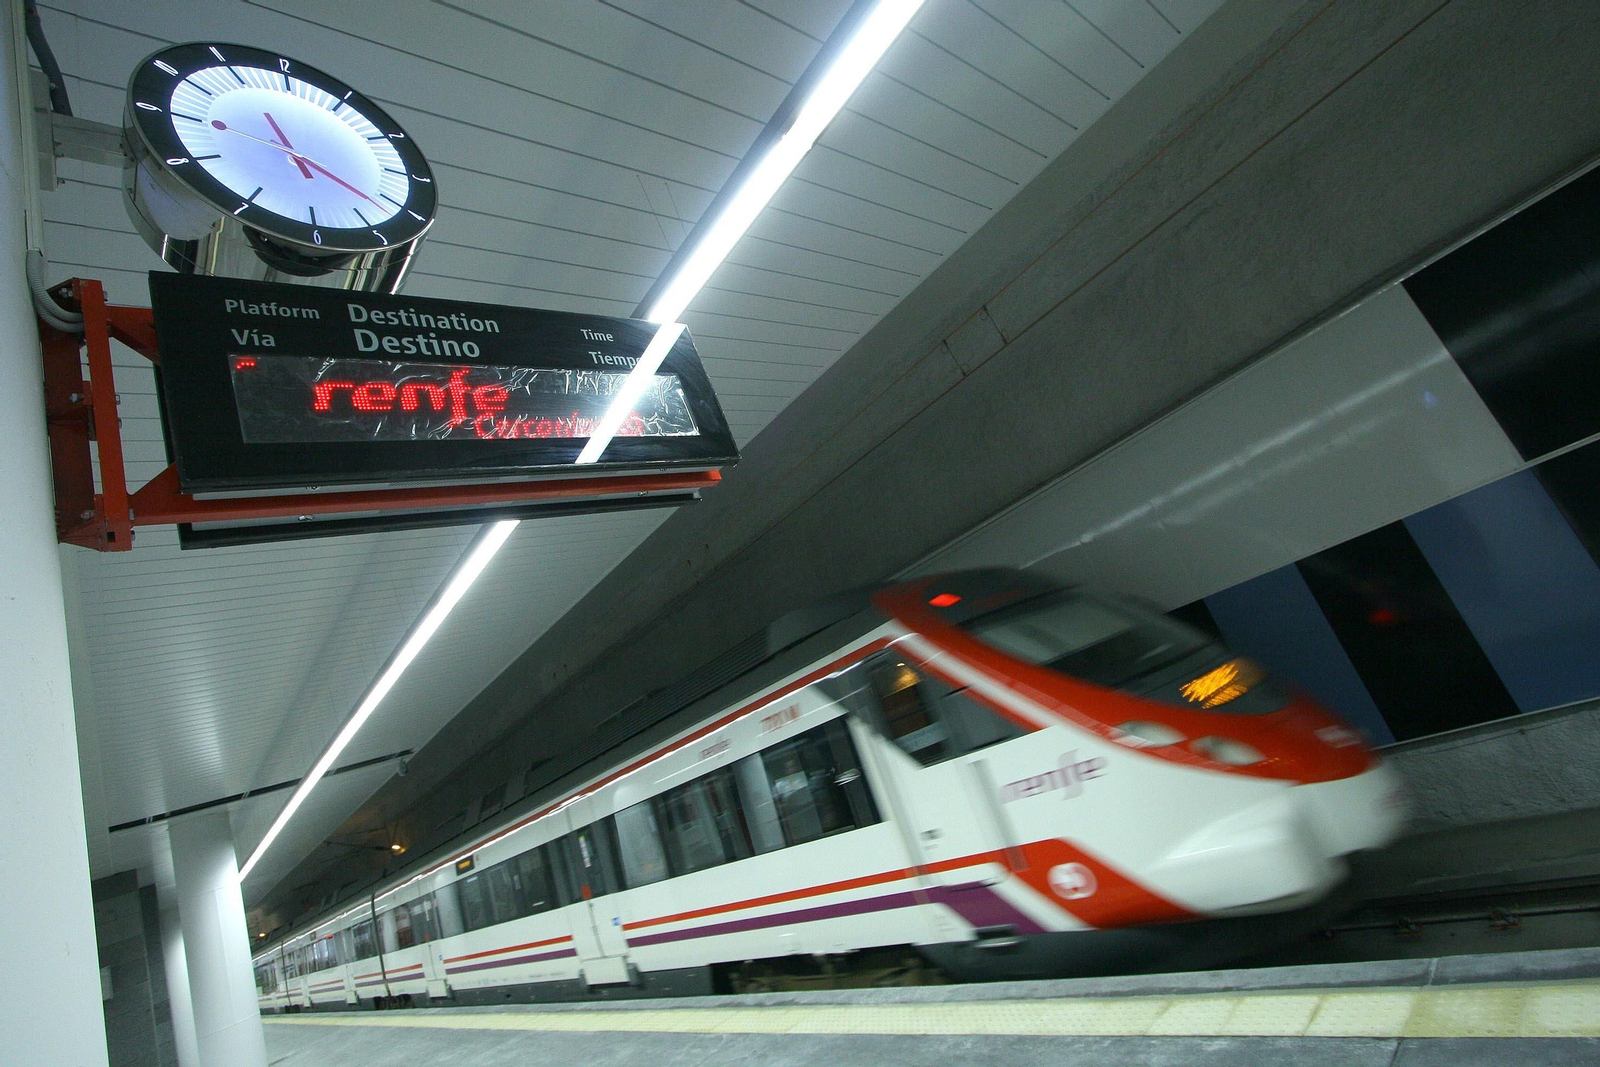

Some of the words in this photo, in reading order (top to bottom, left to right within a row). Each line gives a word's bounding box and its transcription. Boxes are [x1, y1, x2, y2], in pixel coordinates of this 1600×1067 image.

[153, 59, 179, 77] 10
[278, 58, 291, 73] 12
[343, 90, 353, 99] 1
[135, 102, 162, 112] 9
[388, 131, 405, 139] 2
[166, 157, 190, 166] 8
[412, 174, 431, 183] 3
[233, 202, 249, 216] 7
[408, 209, 426, 221] 4
[312, 230, 323, 245] 6
[372, 229, 389, 246] 5
[224, 299, 321, 320] Platform
[347, 303, 500, 333] Destination
[231, 328, 276, 347] Vía
[580, 328, 614, 342] Time
[353, 328, 481, 358] Destino
[588, 351, 640, 369] Tiemp
[313, 366, 509, 428] renfe
